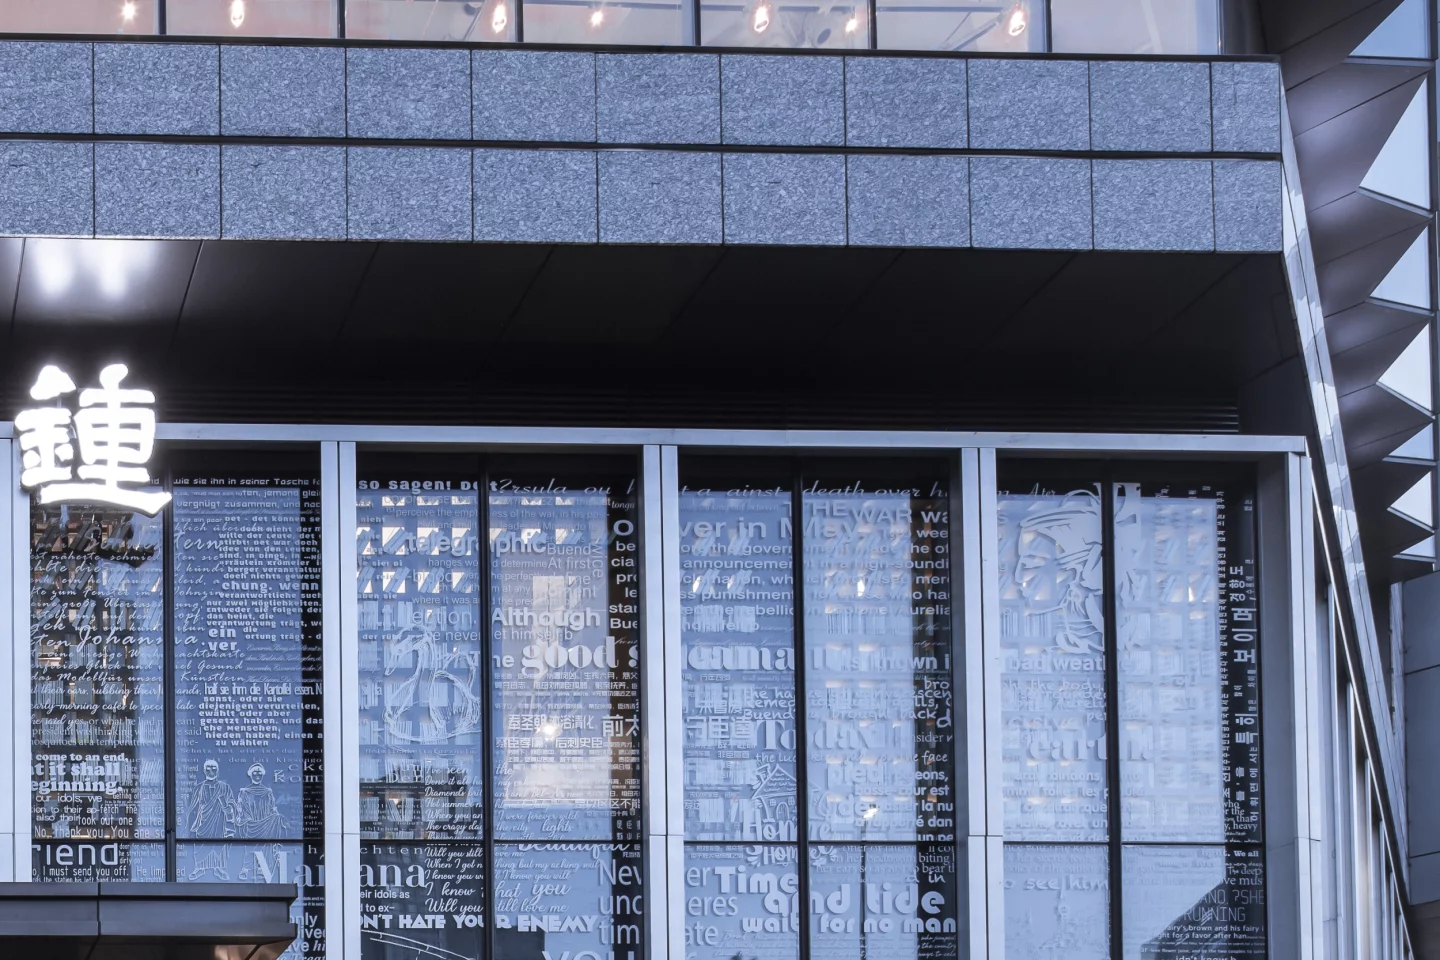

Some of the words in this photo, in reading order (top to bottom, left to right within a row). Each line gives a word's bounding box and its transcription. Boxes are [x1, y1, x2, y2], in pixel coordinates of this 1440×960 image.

[209, 626, 236, 638] ein
[36, 753, 67, 761] come
[50, 761, 65, 775] it
[71, 761, 120, 776] shall
[374, 890, 397, 899] idols
[532, 884, 571, 904] you
[867, 884, 945, 914] tide
[425, 899, 456, 912] Will
[398, 915, 445, 929] HATE
[518, 916, 598, 932] ENEMY
[820, 916, 855, 932] for
[864, 920, 893, 932] no
[904, 918, 956, 932] man
